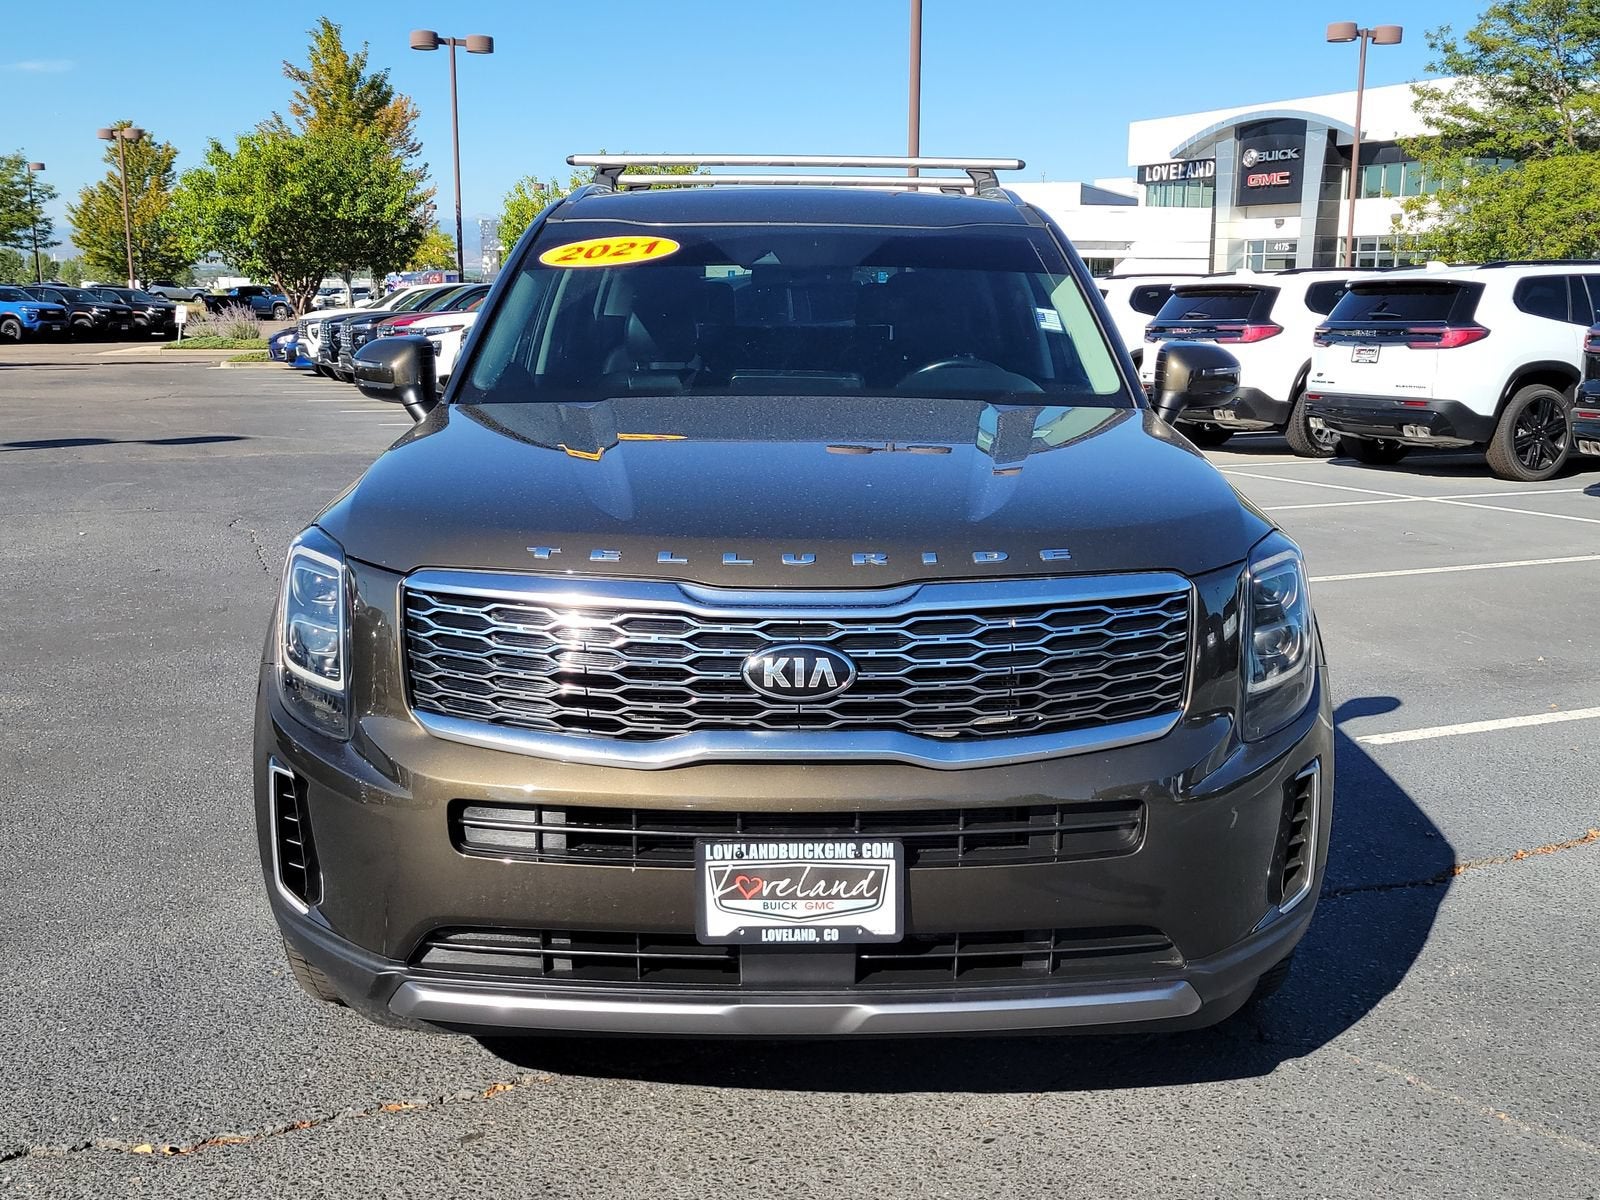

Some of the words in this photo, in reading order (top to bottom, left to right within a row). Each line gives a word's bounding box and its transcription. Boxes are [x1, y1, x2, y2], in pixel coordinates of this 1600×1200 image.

[1255, 147, 1300, 163] BUICK
[1145, 160, 1216, 182] LOVELAND
[1247, 171, 1290, 187] GMC
[555, 240, 661, 262] 2021
[1274, 242, 1290, 251] 4175
[526, 547, 1073, 566] TELLURIDE
[763, 656, 838, 688] KIA
[705, 842, 894, 860] LOVELANDBUICKGMCCOM
[714, 864, 879, 900] Loveland
[762, 901, 798, 911] BUICK
[804, 901, 835, 910] GMC
[761, 928, 820, 942] LOVELAND,
[823, 928, 839, 941] CO
